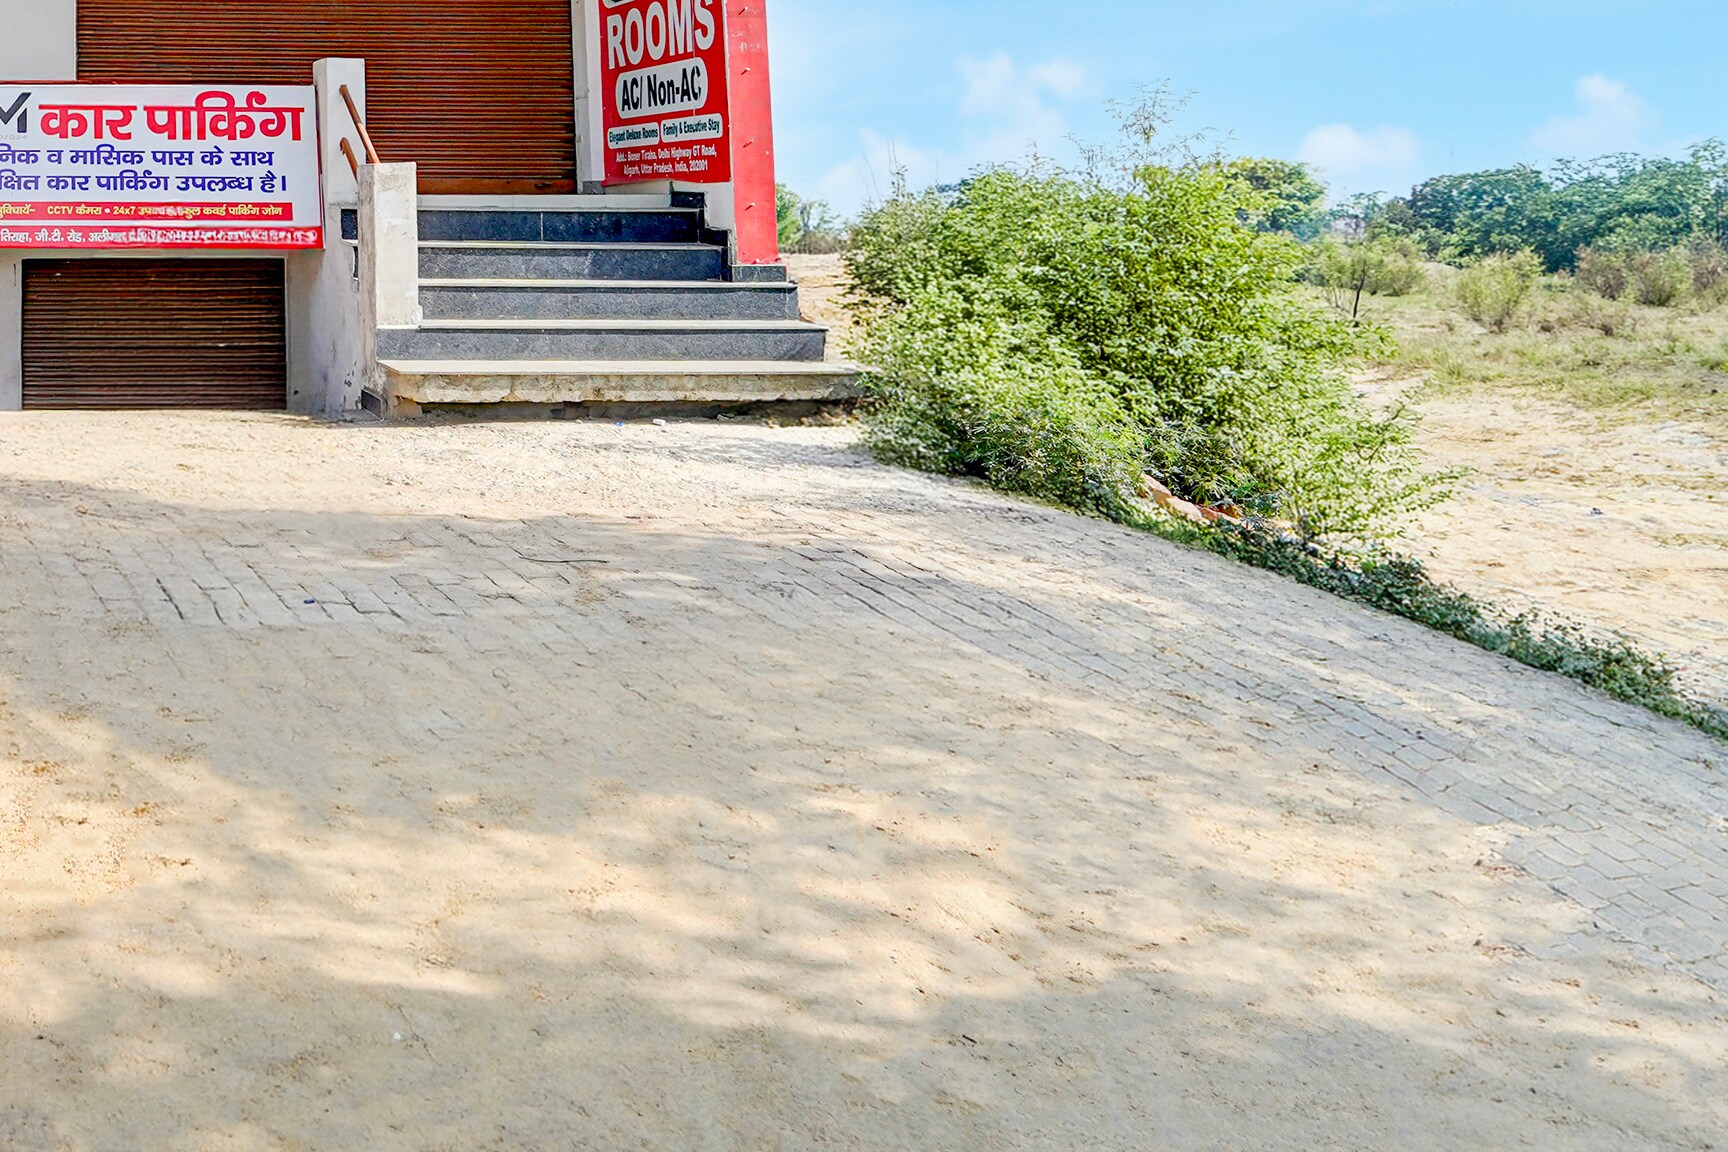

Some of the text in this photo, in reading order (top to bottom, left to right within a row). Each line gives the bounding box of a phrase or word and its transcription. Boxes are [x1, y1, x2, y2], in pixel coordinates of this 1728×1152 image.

[647, 65, 702, 108] Non-AC
[38, 104, 137, 141] कार
[708, 118, 720, 134] Stay
[46, 150, 64, 165] व
[69, 143, 146, 165] मासिक
[151, 151, 194, 166] पास
[200, 145, 224, 166] के
[230, 151, 275, 166] साथ
[693, 145, 700, 157] GT
[46, 175, 91, 191] कार
[175, 176, 254, 192] उपलब्ध
[47, 206, 73, 215] CCTV
[112, 206, 135, 215] 24x7
